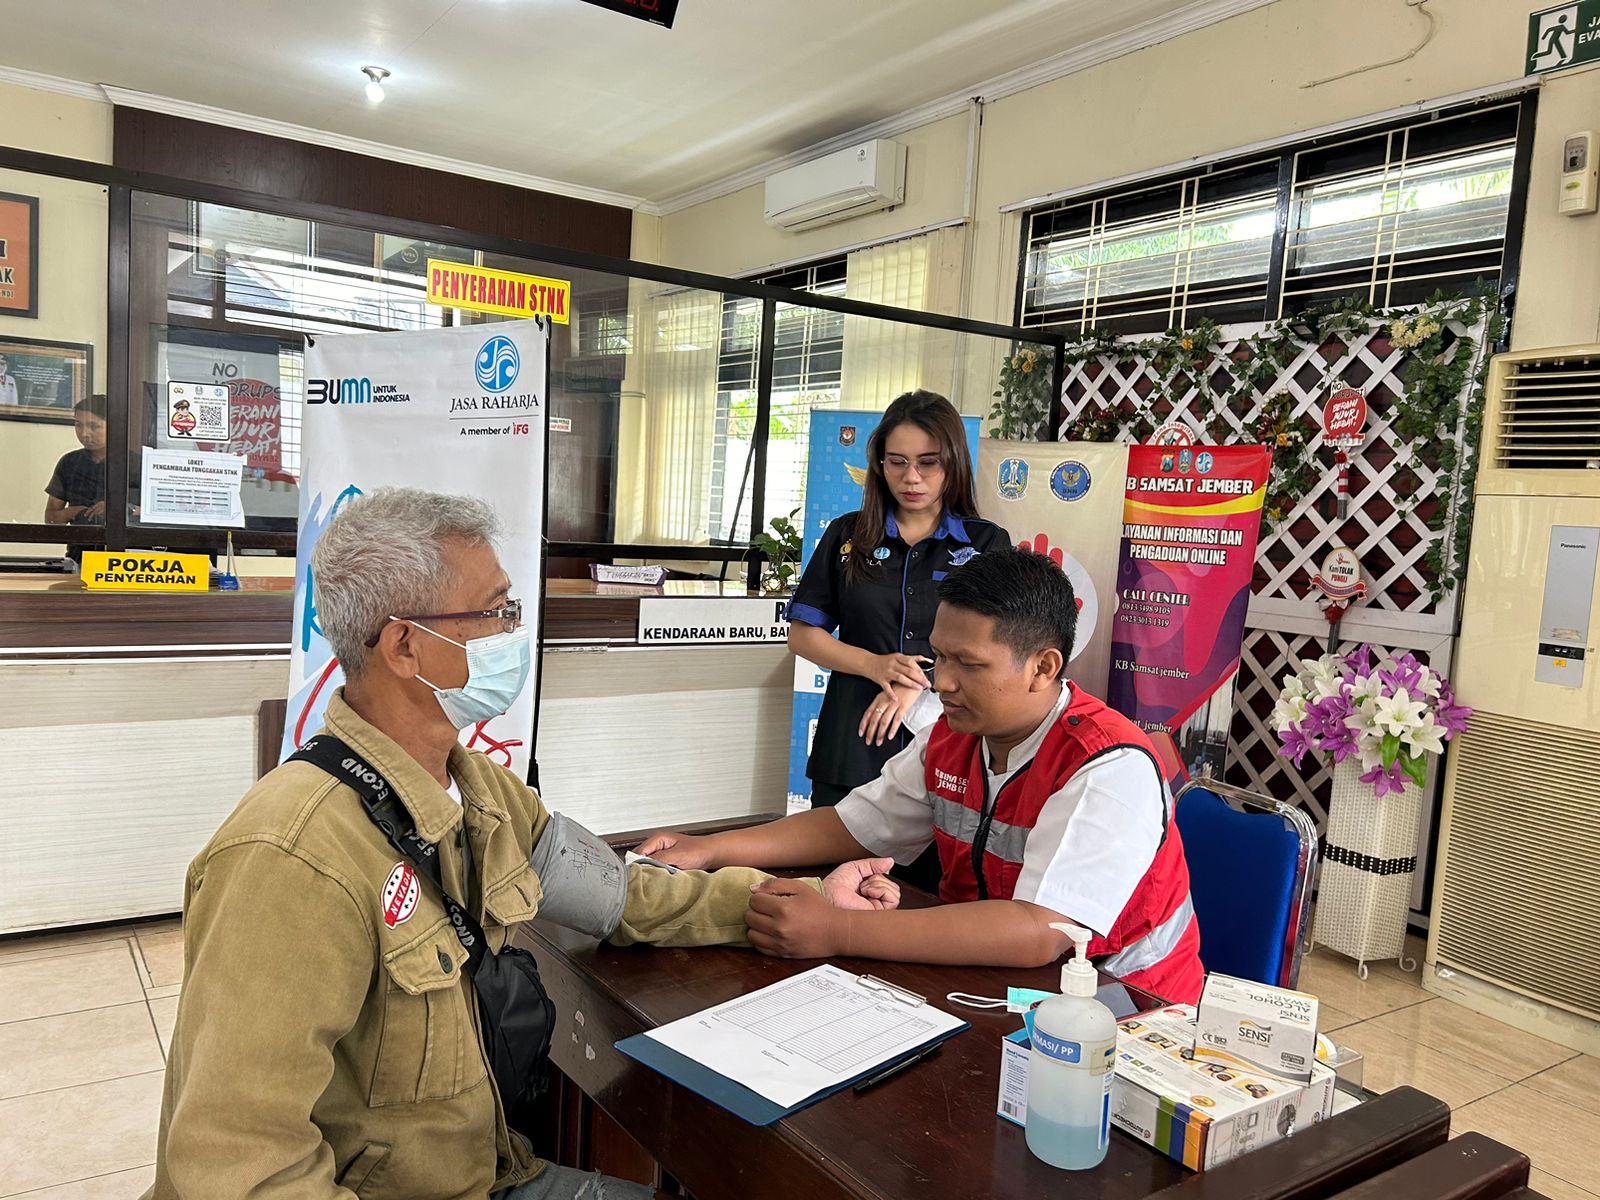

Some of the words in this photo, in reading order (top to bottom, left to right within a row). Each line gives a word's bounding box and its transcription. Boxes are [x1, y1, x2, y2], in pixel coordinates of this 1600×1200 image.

[432, 268, 526, 309] PENYERAHAN
[529, 283, 566, 315] STNK
[212, 362, 238, 378] NO
[373, 385, 397, 394] UNTUK
[373, 394, 410, 403] INDONESIA
[449, 397, 478, 413] JASA
[481, 393, 540, 410] RAHARJA
[460, 427, 467, 435] A
[468, 427, 501, 436] member
[502, 426, 510, 435] of
[152, 463, 191, 473] PENGAMBILAN
[191, 466, 223, 475] TUNGGAKAN
[224, 468, 238, 476] STNK
[187, 458, 204, 466] LOKET
[1139, 477, 1194, 493] SAMSAT
[1196, 479, 1254, 494] JEMBER
[1163, 526, 1219, 544] INFORMASI
[1220, 529, 1243, 546] DAN
[1129, 544, 1189, 562] PENGADUAN
[1190, 548, 1227, 565] ONLINE
[107, 557, 184, 574] POKJA
[94, 573, 196, 585] PENYERAHAN
[1123, 588, 1146, 601] CALL
[1149, 591, 1190, 606] CENTER
[643, 627, 725, 640] KENDARAAN
[729, 626, 766, 640] BARU,
[1115, 659, 1129, 670] KB
[1129, 661, 1159, 674] Samsat
[1160, 666, 1190, 680] jember
[391, 871, 414, 916] NEVADA
[1246, 992, 1311, 1013] ALCOHOL
[1278, 1009, 1311, 1022] SENSI
[1238, 1026, 1271, 1044] SENSI
[1061, 1045, 1075, 1056] PP
